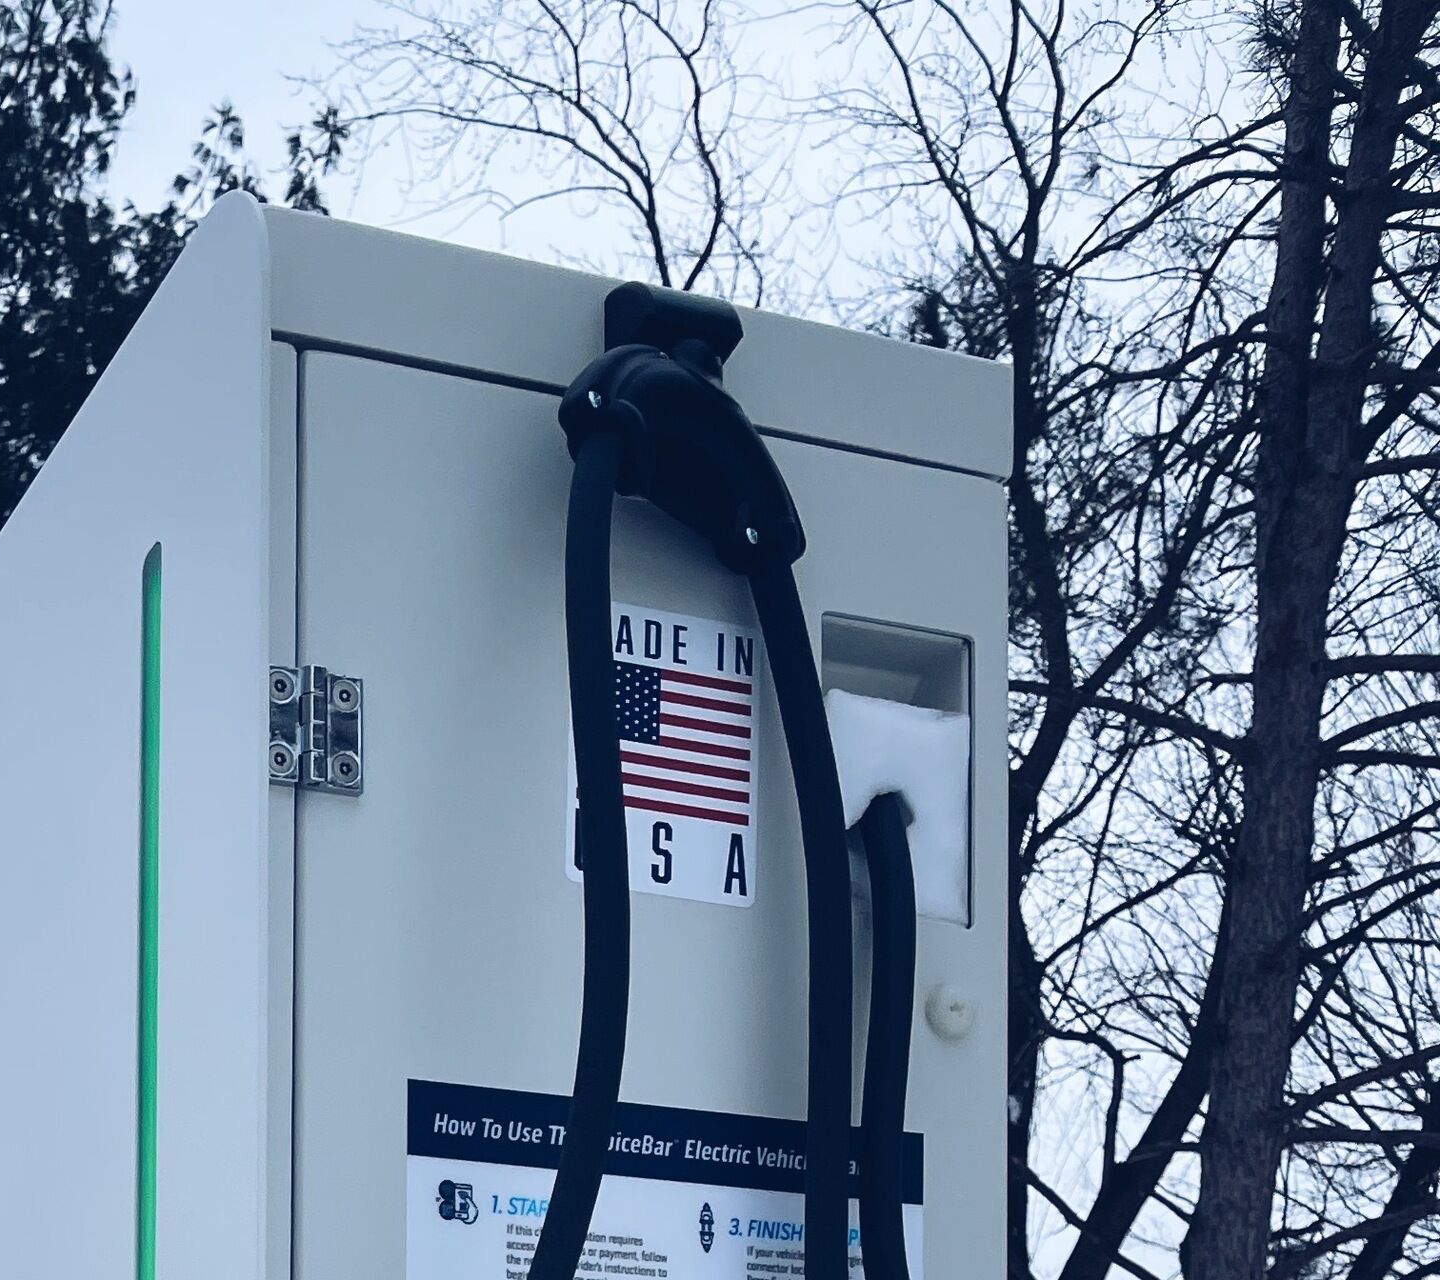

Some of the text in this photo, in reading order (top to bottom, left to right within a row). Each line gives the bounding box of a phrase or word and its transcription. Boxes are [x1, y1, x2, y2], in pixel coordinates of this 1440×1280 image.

[615, 614, 754, 677] ADE IN
[433, 1112, 476, 1137] How
[481, 1117, 503, 1140] To
[508, 1120, 544, 1144] Use
[684, 1139, 752, 1165] Electric
[756, 1146, 808, 1171] Vehicl
[491, 1194, 503, 1215] 1.
[506, 1223, 514, 1235] If
[515, 1224, 533, 1237] this
[729, 1217, 804, 1242] 3. FINISH
[608, 1233, 644, 1248] requires
[506, 1253, 522, 1265] the
[641, 1250, 668, 1263] follow
[604, 1262, 657, 1278] instructions
[658, 1267, 668, 1278] to
